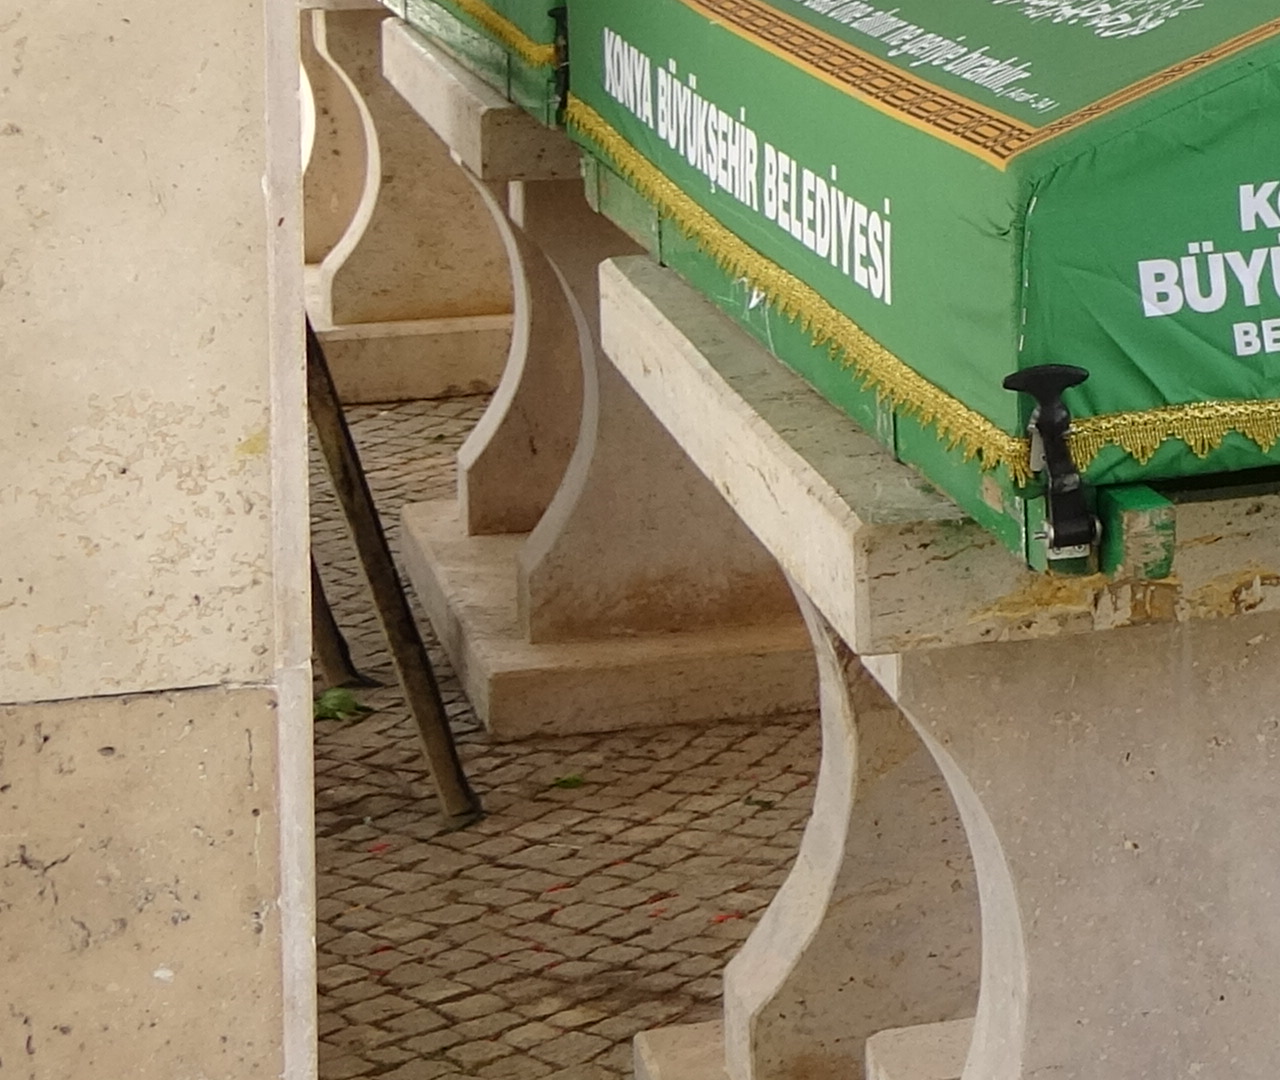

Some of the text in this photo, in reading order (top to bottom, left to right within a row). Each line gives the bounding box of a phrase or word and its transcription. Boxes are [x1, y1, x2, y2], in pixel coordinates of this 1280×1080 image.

[603, 26, 892, 306] KONYA BÜYÜKŞEHİR BELEDİYESİ
